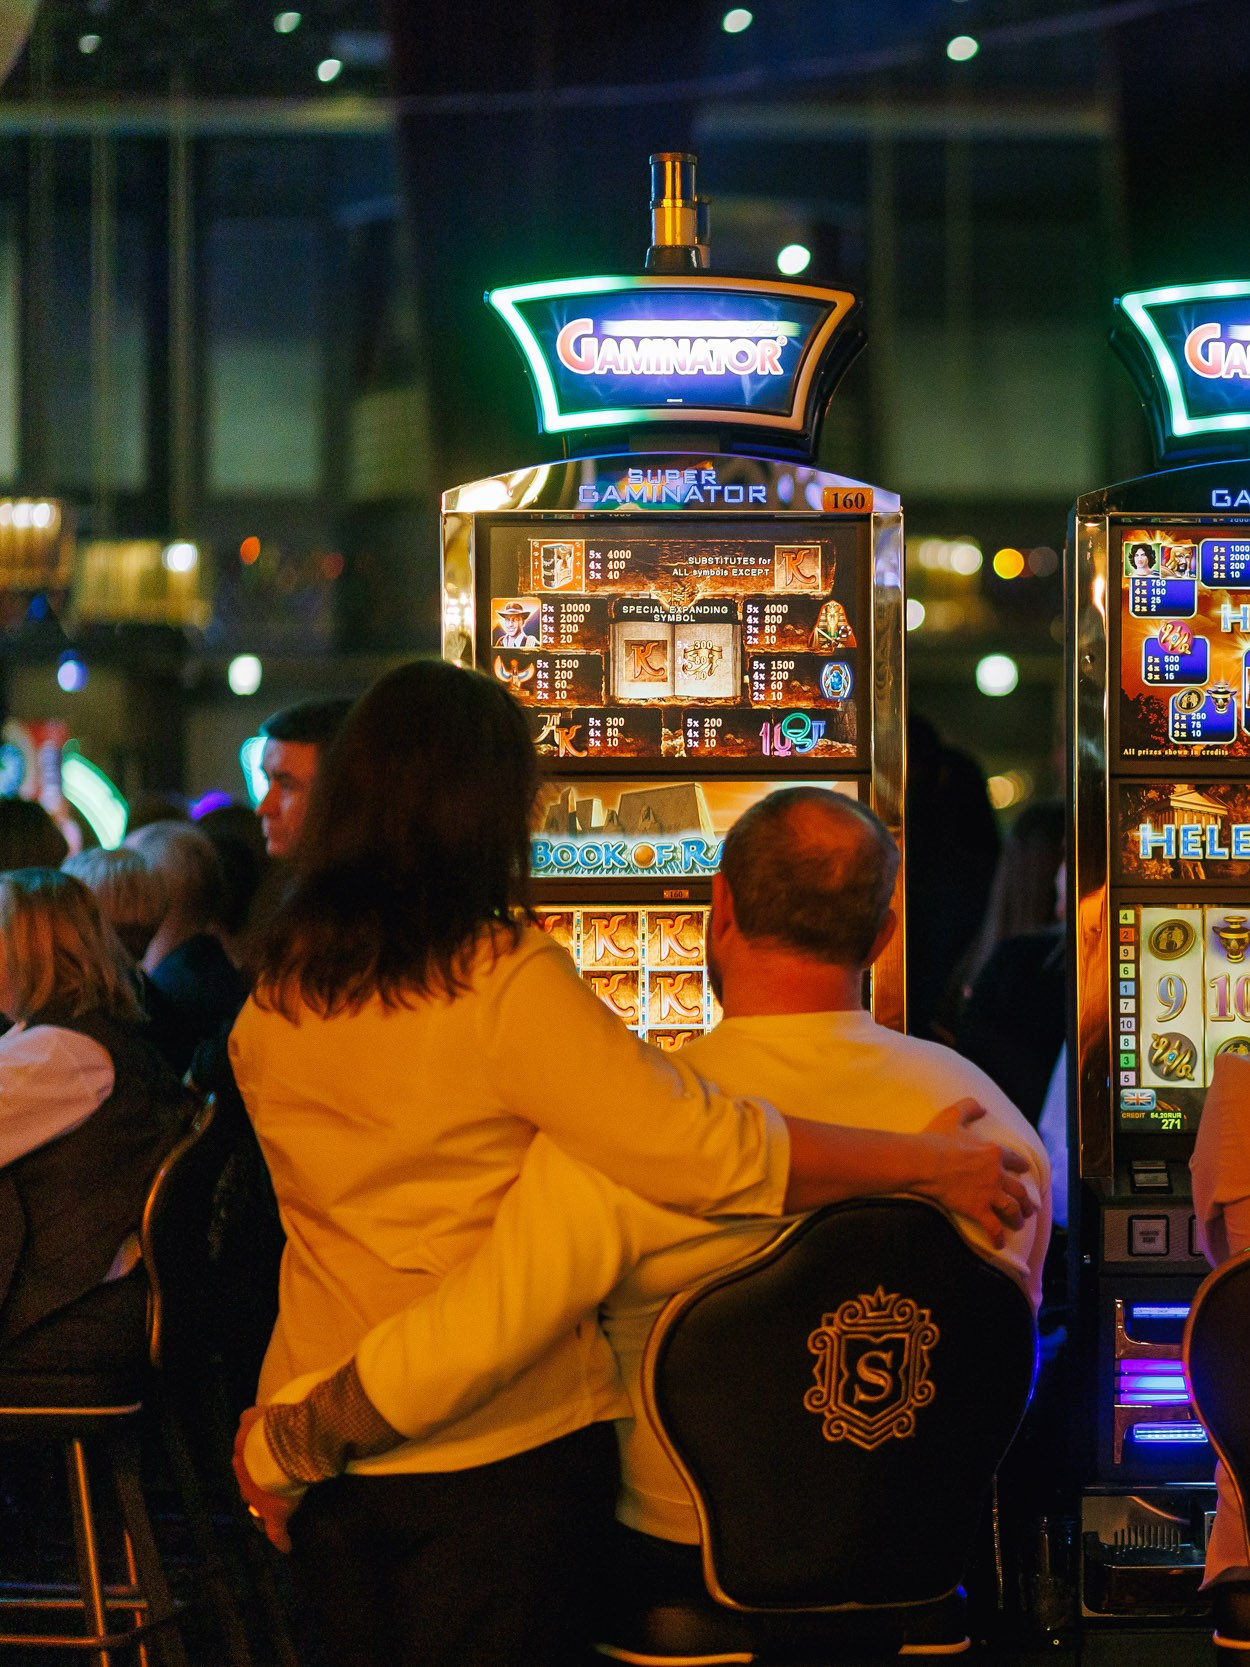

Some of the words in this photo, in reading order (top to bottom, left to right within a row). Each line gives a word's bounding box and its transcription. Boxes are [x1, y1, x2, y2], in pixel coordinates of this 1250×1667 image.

[628, 468, 717, 485] SUPER
[578, 485, 767, 504] GAMINATOR
[830, 492, 866, 510] 160
[589, 551, 601, 559] 5x
[607, 550, 631, 559] 4000
[589, 561, 601, 569] 4x
[607, 560, 625, 569] 400
[608, 571, 619, 579] 40
[693, 569, 728, 577] symbols
[542, 604, 554, 612] 5x
[561, 604, 590, 613] 10000
[746, 605, 759, 613] 5x
[764, 605, 788, 613] 4000
[542, 615, 554, 623] 4x
[560, 614, 584, 623] 2000
[765, 615, 782, 624] 800
[542, 625, 554, 633] 3x
[560, 624, 578, 633] 200
[555, 660, 579, 668] 1500
[771, 661, 794, 670] 1500
[537, 671, 549, 679] 4x
[555, 671, 573, 679] 200
[753, 672, 765, 680] 4x
[770, 672, 788, 680] 200
[589, 718, 601, 726] 5x
[606, 718, 624, 726] 300
[687, 719, 699, 727] 5x
[704, 719, 722, 727] 200
[589, 729, 601, 737] 4x
[607, 728, 619, 737] 80
[687, 729, 699, 737] 4x
[705, 729, 716, 737] 50
[607, 738, 618, 747] 10
[687, 739, 699, 747] 3x
[705, 739, 716, 747] 10
[531, 839, 628, 869] BOOK
[632, 842, 674, 868] OF
[1123, 967, 1129, 975] 6
[1156, 974, 1187, 1022] 9
[1161, 1119, 1180, 1129] 271
[853, 1351, 893, 1403] S
